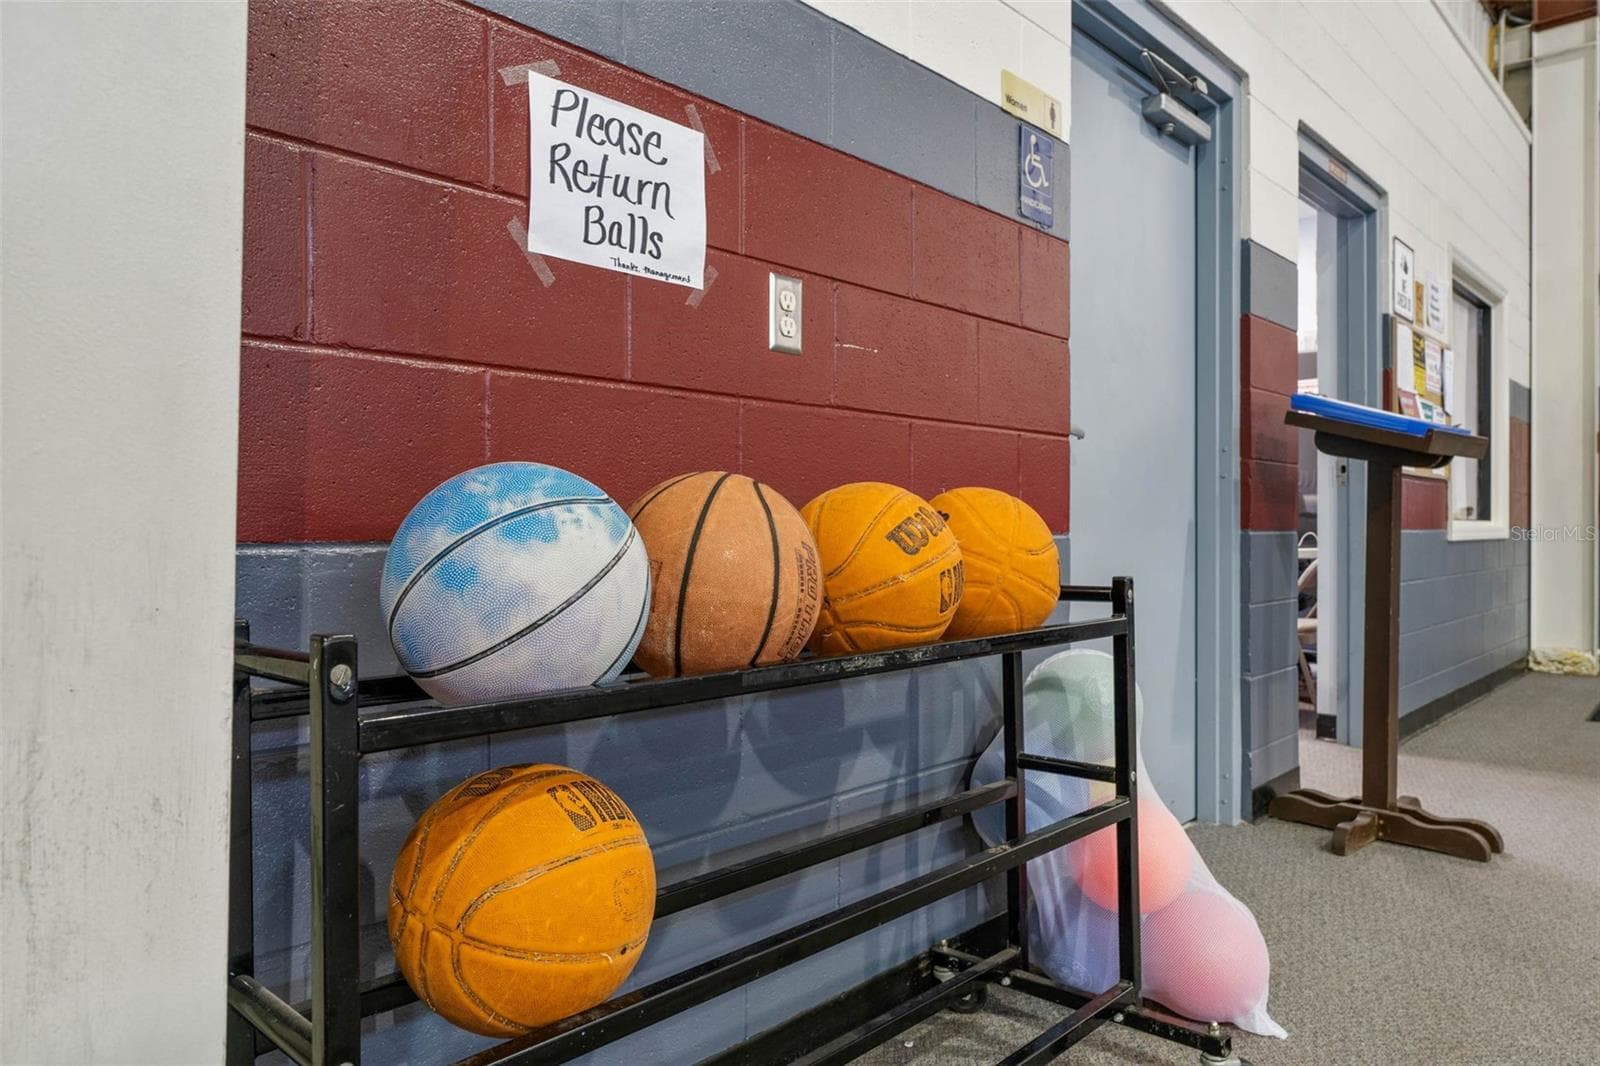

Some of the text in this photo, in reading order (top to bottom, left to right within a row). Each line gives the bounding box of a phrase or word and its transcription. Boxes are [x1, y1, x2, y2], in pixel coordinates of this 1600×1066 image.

[550, 88, 668, 165] Please
[549, 142, 675, 220] Return
[583, 205, 664, 260] Balls
